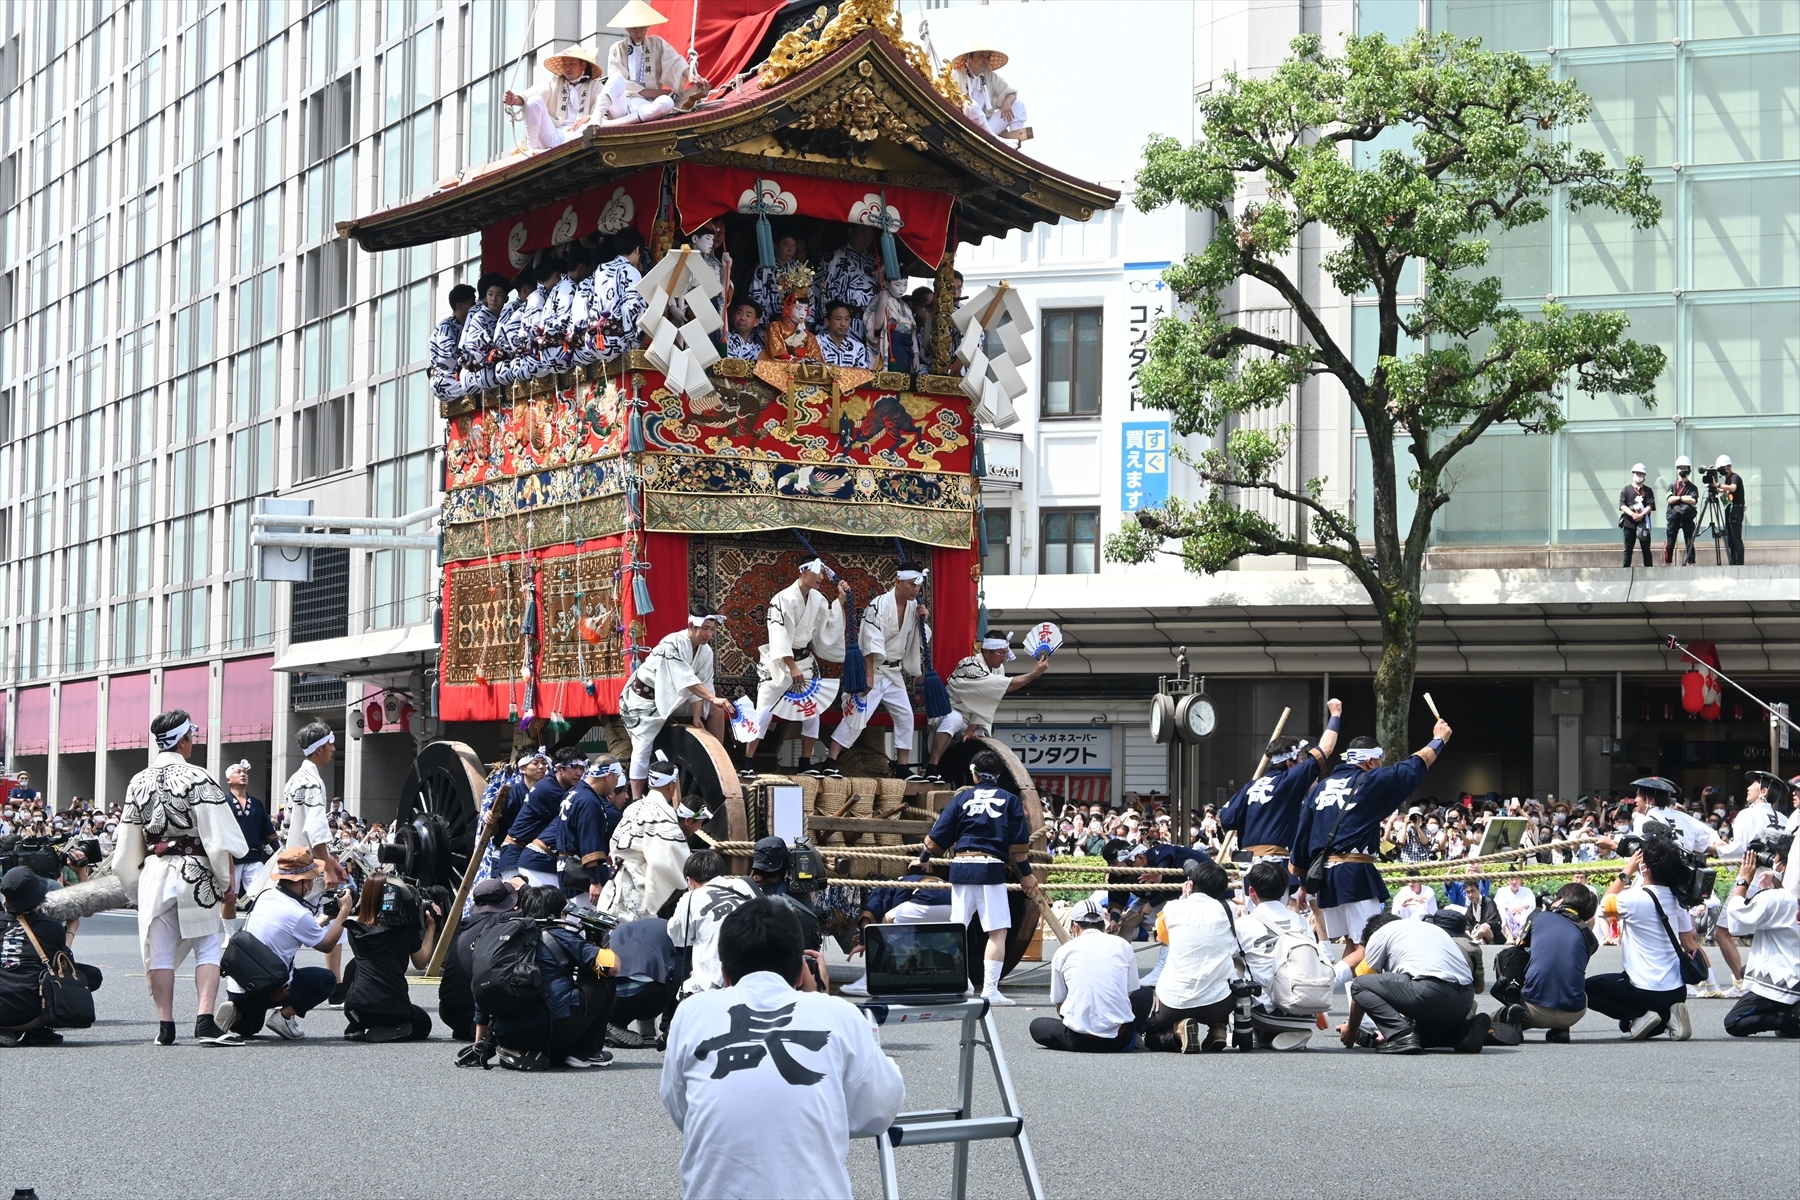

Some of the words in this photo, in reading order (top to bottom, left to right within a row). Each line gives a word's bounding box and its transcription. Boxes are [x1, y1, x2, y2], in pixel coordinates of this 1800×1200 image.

[1147, 431, 1163, 471] すぐ
[1125, 430, 1144, 509] 買えます
[1039, 732, 1098, 743] メガネスーパー
[1011, 746, 1098, 765] コンタクト
